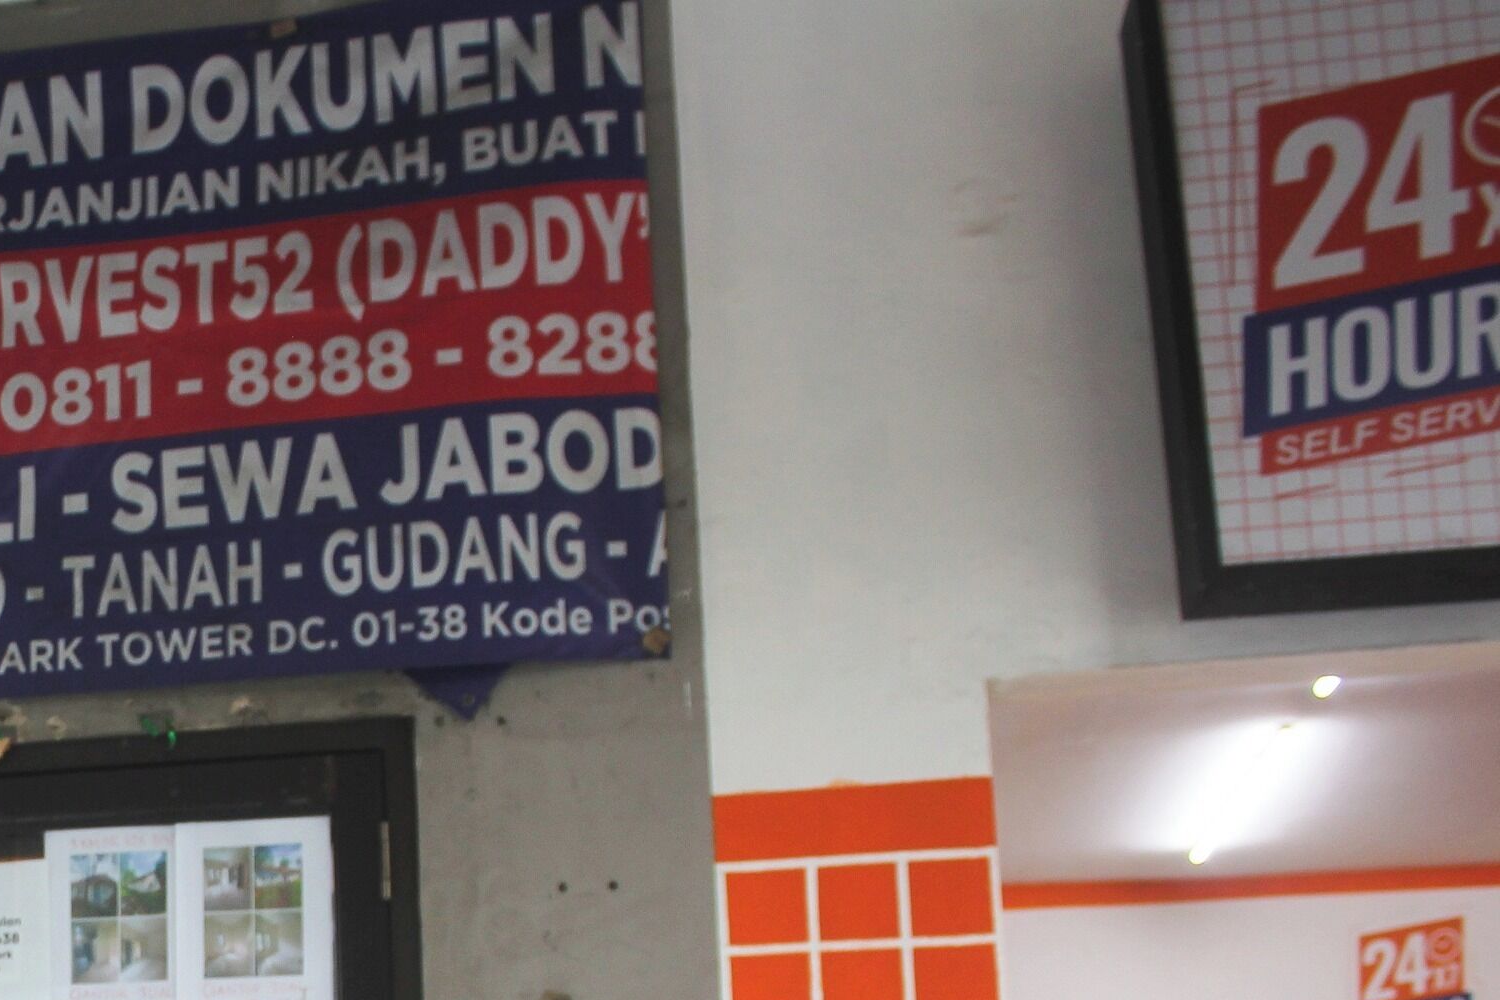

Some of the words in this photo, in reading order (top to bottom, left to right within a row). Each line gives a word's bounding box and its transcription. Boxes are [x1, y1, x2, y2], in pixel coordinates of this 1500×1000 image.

[130, 13, 555, 154] DOKUMEN
[257, 141, 447, 205] NIKAH,
[462, 110, 618, 172] BUAT
[1273, 93, 1470, 290] 24
[0, 360, 152, 432] 0811
[226, 329, 412, 408] 8888
[110, 432, 358, 533] SEWA
[380, 406, 662, 505] JABOD
[1274, 417, 1381, 466] SELF
[61, 539, 263, 618] TANAH
[322, 511, 586, 596] GUDANG
[96, 623, 253, 669] TOWER
[268, 616, 340, 655] DC.
[352, 603, 467, 647] 01-38
[482, 598, 593, 637] Kode
